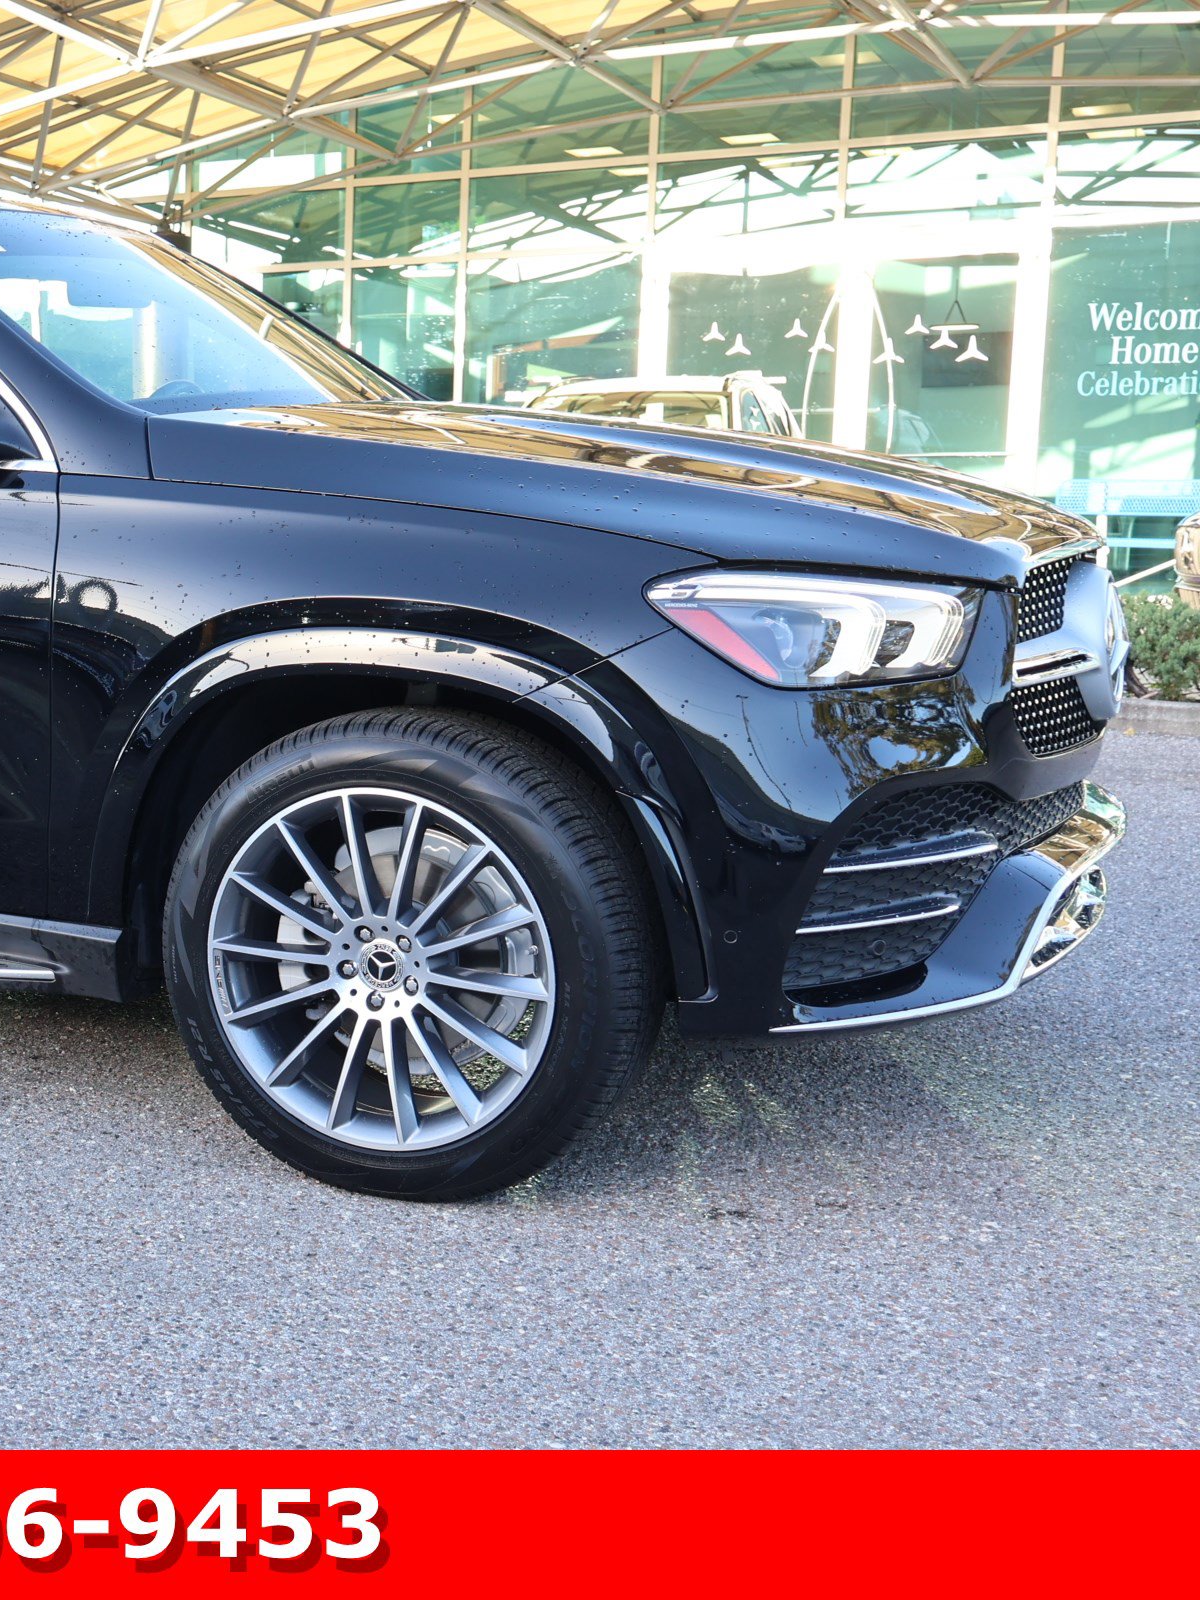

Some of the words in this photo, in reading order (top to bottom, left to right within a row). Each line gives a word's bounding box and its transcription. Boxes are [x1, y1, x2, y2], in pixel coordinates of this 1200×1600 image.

[1108, 335, 1199, 365] Home
[1076, 370, 1200, 397] Celebrati
[246, 753, 315, 803] PIRELLI
